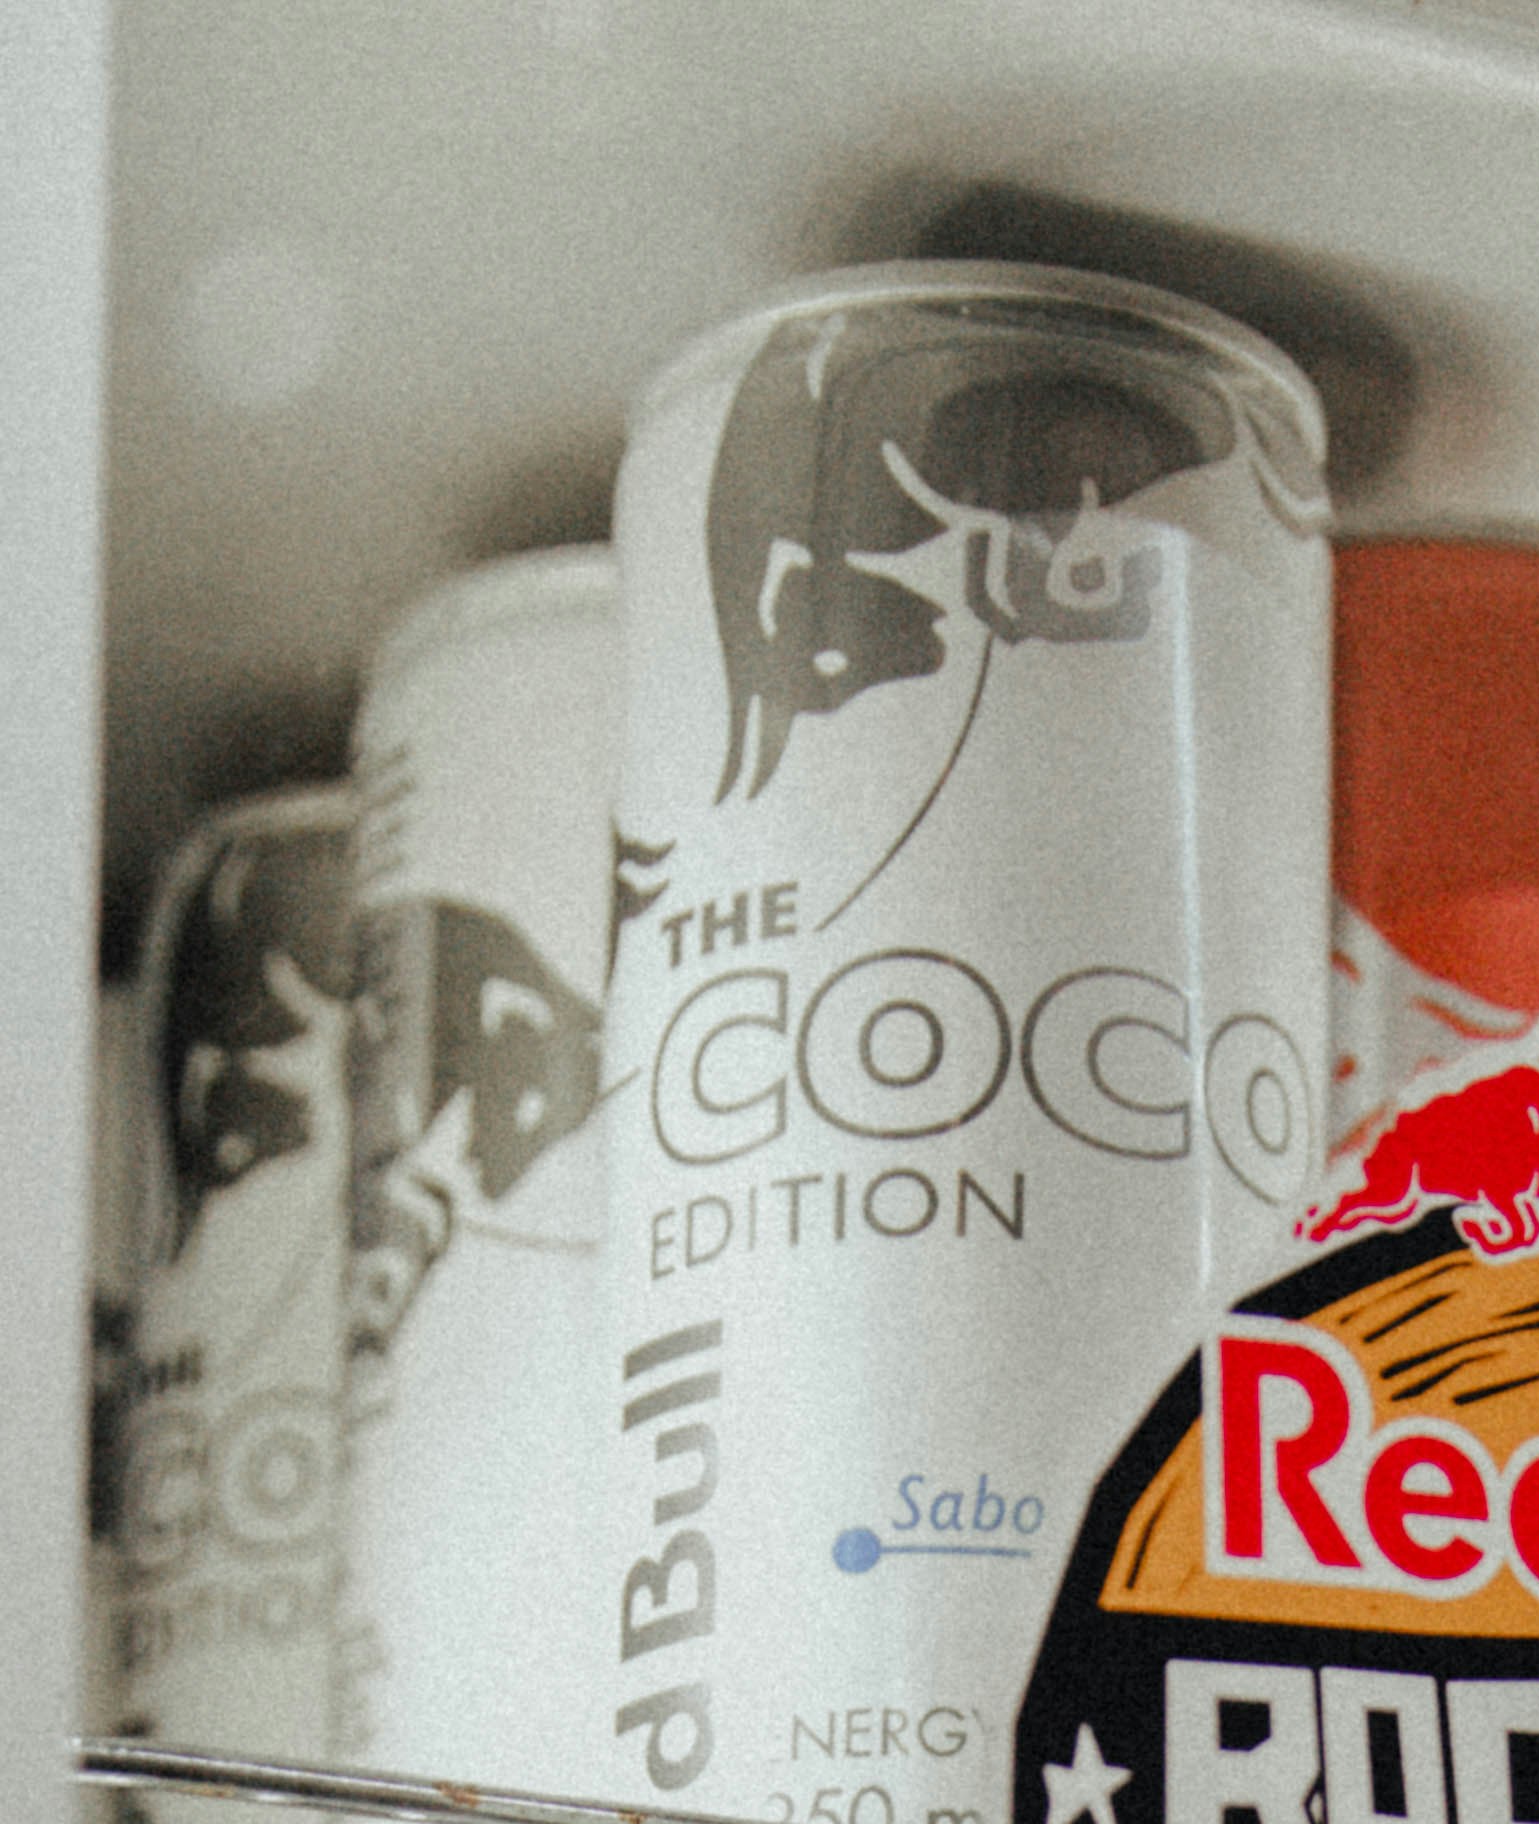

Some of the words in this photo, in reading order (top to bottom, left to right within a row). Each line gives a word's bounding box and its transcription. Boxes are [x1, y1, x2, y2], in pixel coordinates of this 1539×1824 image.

[661, 882, 800, 967] THE
[651, 948, 1310, 1206] COCO
[650, 1170, 1026, 1282] EDITION
[621, 1318, 723, 1664] Bull
[892, 1473, 1045, 1535] Sabo
